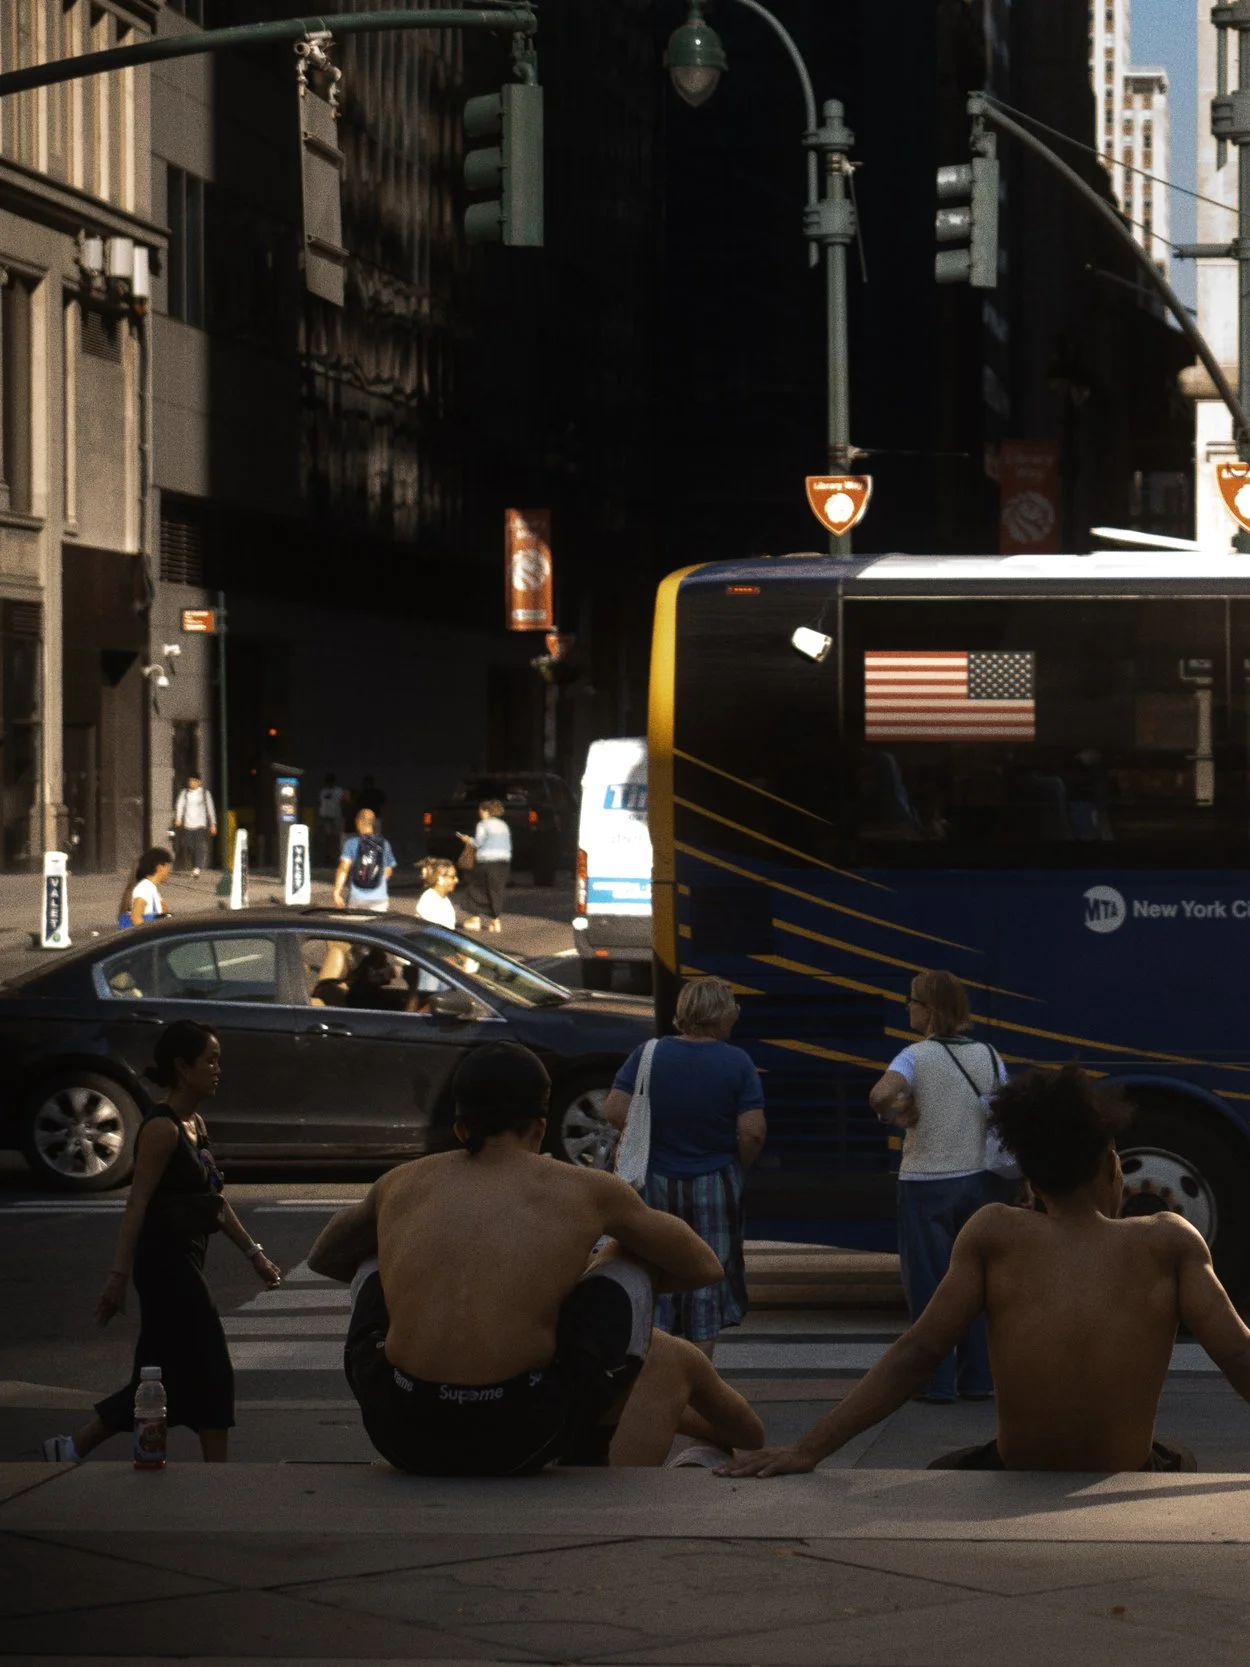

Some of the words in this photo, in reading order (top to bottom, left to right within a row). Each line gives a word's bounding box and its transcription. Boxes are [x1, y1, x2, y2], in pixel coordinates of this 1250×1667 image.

[49, 877, 60, 930] VALET
[1132, 899, 1178, 919] New
[1181, 899, 1228, 919] York
